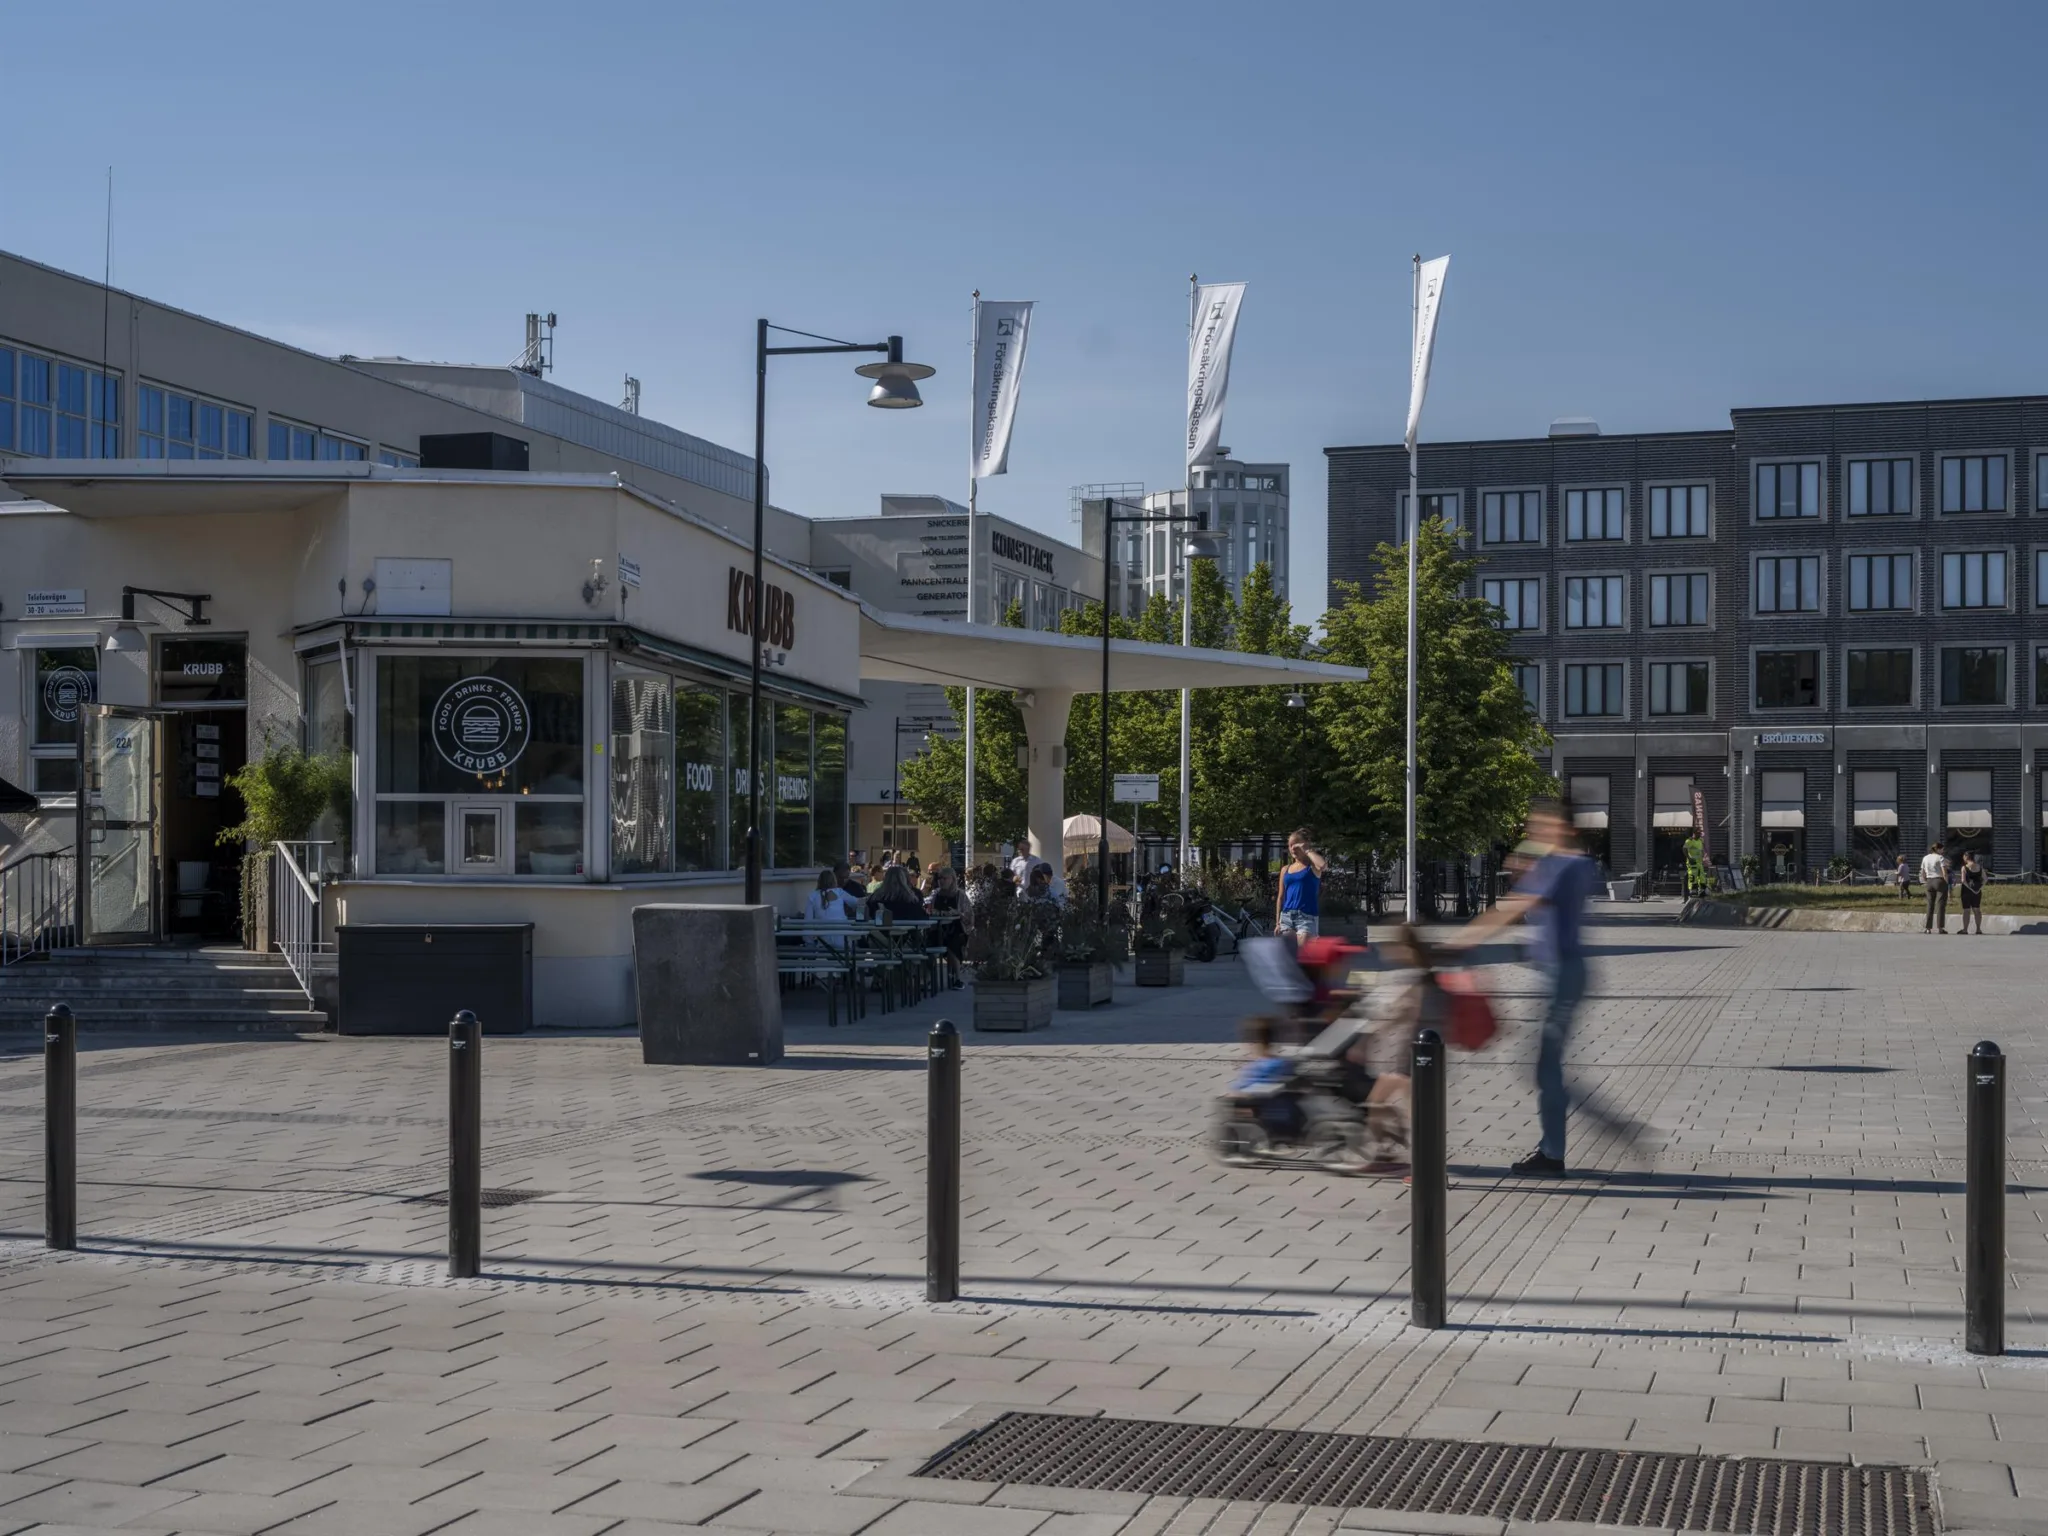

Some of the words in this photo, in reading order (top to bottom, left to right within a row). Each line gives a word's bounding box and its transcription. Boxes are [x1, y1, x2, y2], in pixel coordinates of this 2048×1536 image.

[1187, 326, 1216, 450] Försäkringskassan
[983, 342, 1007, 460] Försäkringskassan
[927, 519, 969, 528] SNICKERIE
[922, 547, 969, 556] HÖGLAGRE
[992, 530, 1054, 574] KONSTFACK
[901, 577, 969, 586] PANNCENTRALE
[28, 593, 67, 602] Telefonvägen
[917, 592, 969, 601] GENERATOR
[728, 567, 794, 650] KRUBB
[183, 663, 223, 675] KRUBB
[54, 708, 78, 719] KRUB
[440, 703, 452, 731] FOOD
[455, 684, 493, 699] DRINKS
[500, 691, 522, 732] FRIENDS
[116, 738, 132, 749] 22A
[1761, 732, 1825, 744] BRÖDERNAS
[453, 750, 507, 769] KRUBB
[686, 762, 712, 792] FOOD
[736, 768, 764, 797] DRIS
[778, 776, 807, 800] FRIENDS
